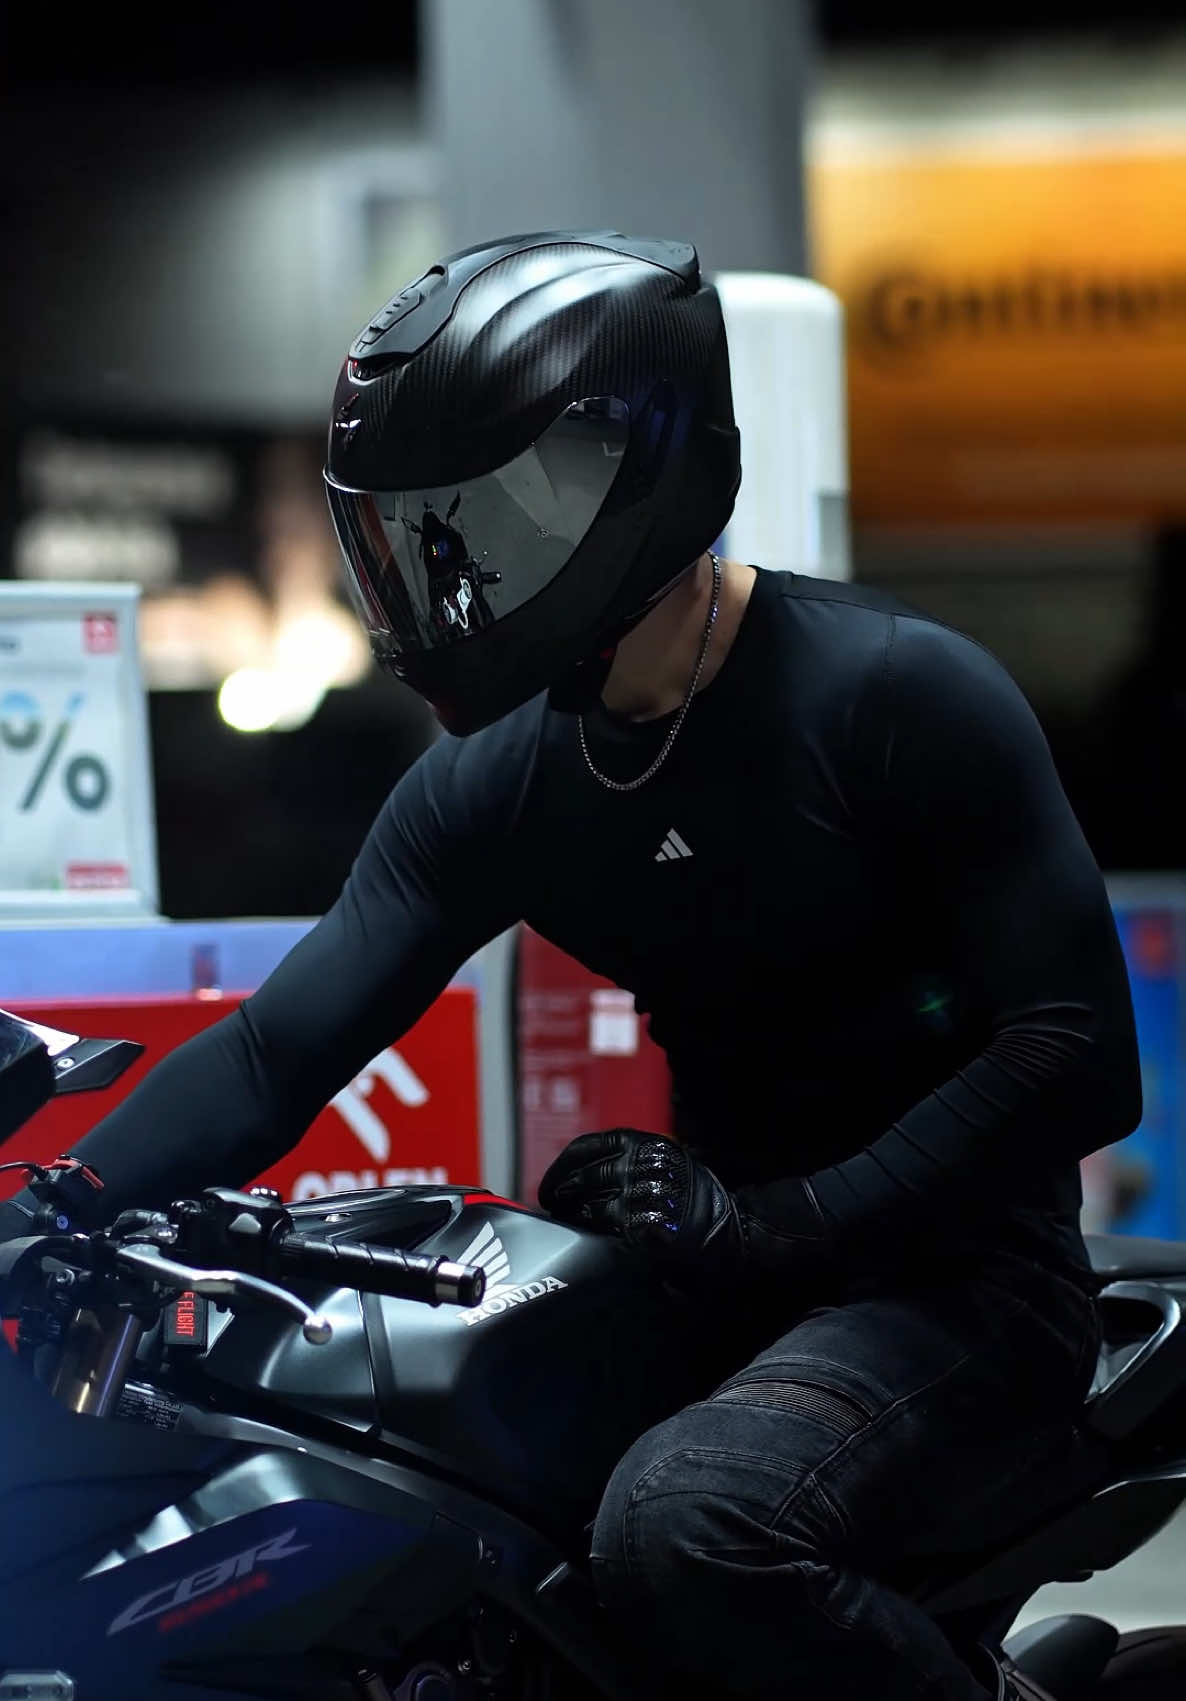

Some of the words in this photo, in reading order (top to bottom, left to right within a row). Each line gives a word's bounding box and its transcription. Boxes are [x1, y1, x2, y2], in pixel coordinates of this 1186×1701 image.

[176, 1300, 195, 1337] FLIGHT
[456, 1276, 569, 1326] HONDA
[106, 1527, 312, 1637] CBR
